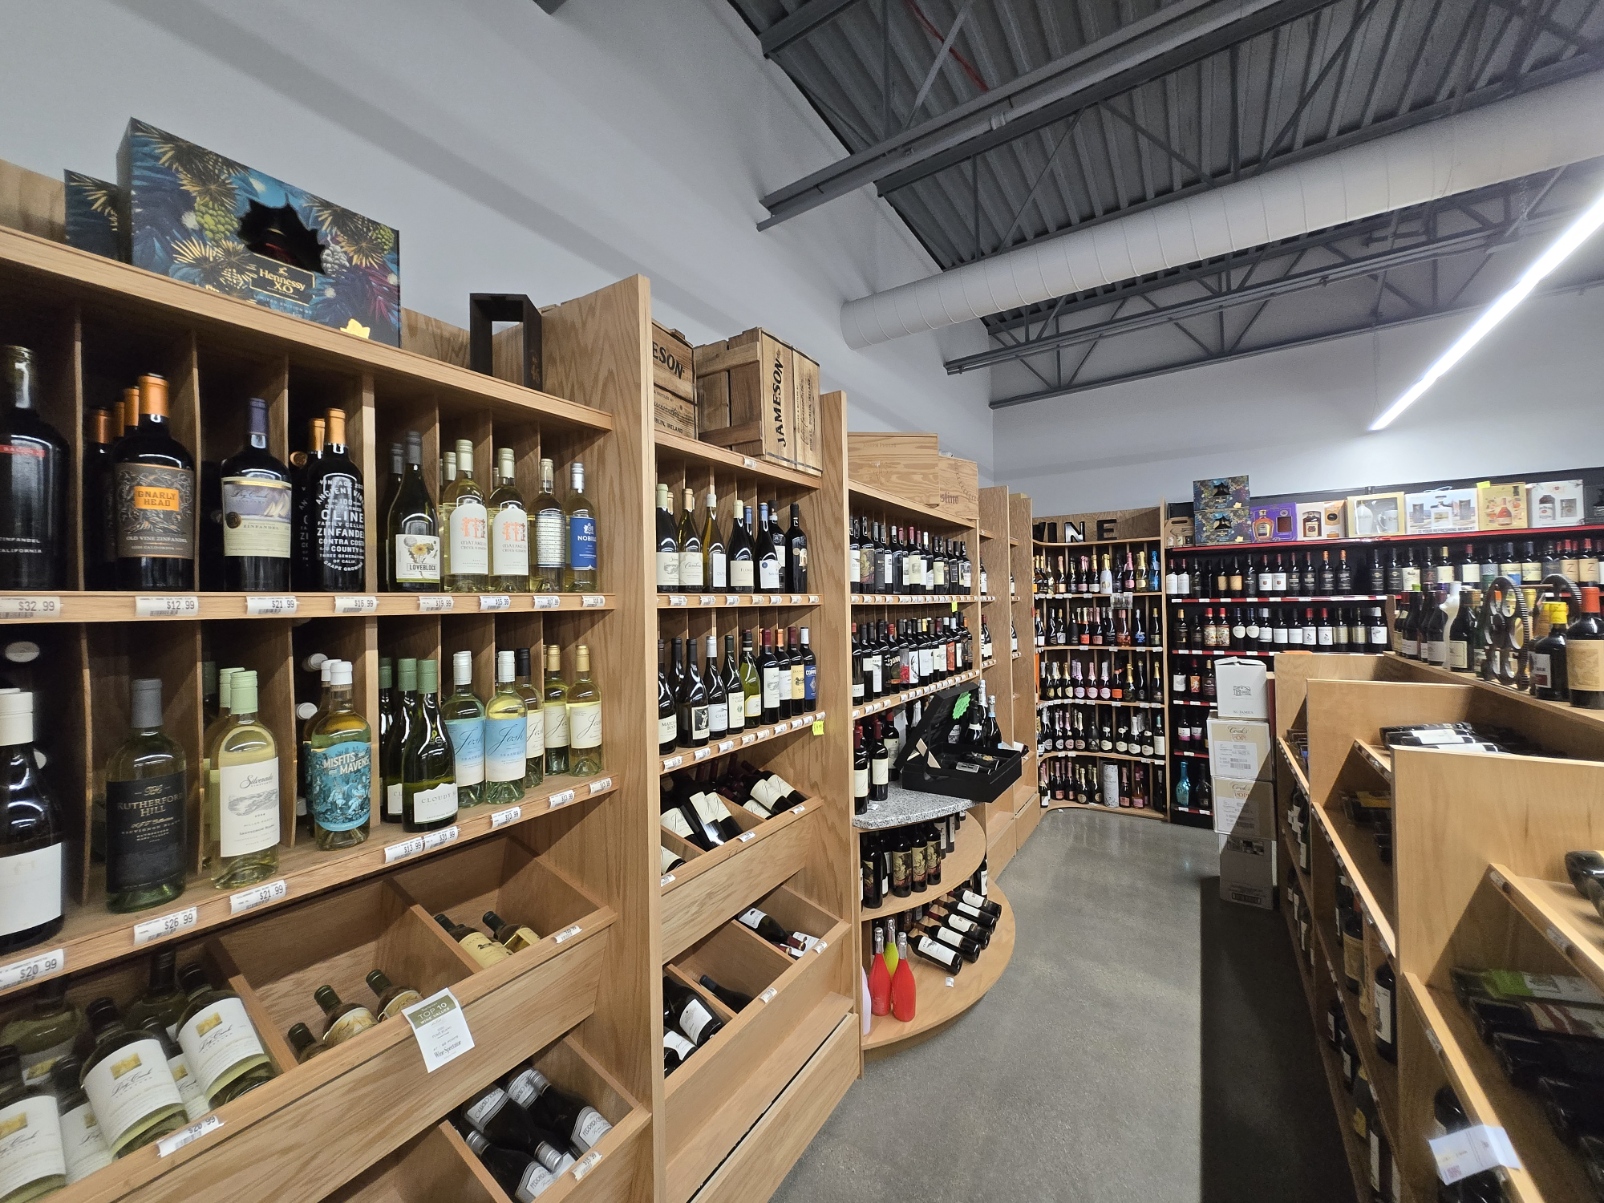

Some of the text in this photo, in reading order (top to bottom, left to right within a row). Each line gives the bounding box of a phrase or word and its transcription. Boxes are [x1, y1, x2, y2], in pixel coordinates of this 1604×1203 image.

[259, 268, 306, 291] Hennessy
[652, 342, 684, 380] ESON
[772, 358, 787, 448] JAMESON
[137, 490, 177, 501] GNARLY
[143, 498, 171, 507] HEAD
[320, 509, 364, 524] CLINE
[317, 520, 343, 528] FAMILY
[318, 538, 349, 546] CONTRA
[330, 545, 360, 553] COUNTY
[18, 600, 55, 612] $32.99
[166, 600, 195, 611] $12.99
[271, 599, 295, 609] $21.99
[488, 723, 524, 756] Josh
[322, 752, 356, 769] MISFITS
[421, 792, 452, 804] CLOUDY
[140, 805, 166, 817] HILL
[259, 884, 284, 901] $21.99
[164, 912, 194, 931] $26.99
[19, 958, 58, 980] $20.99
[418, 1007, 436, 1020] TOP
[436, 1002, 447, 1010] 10
